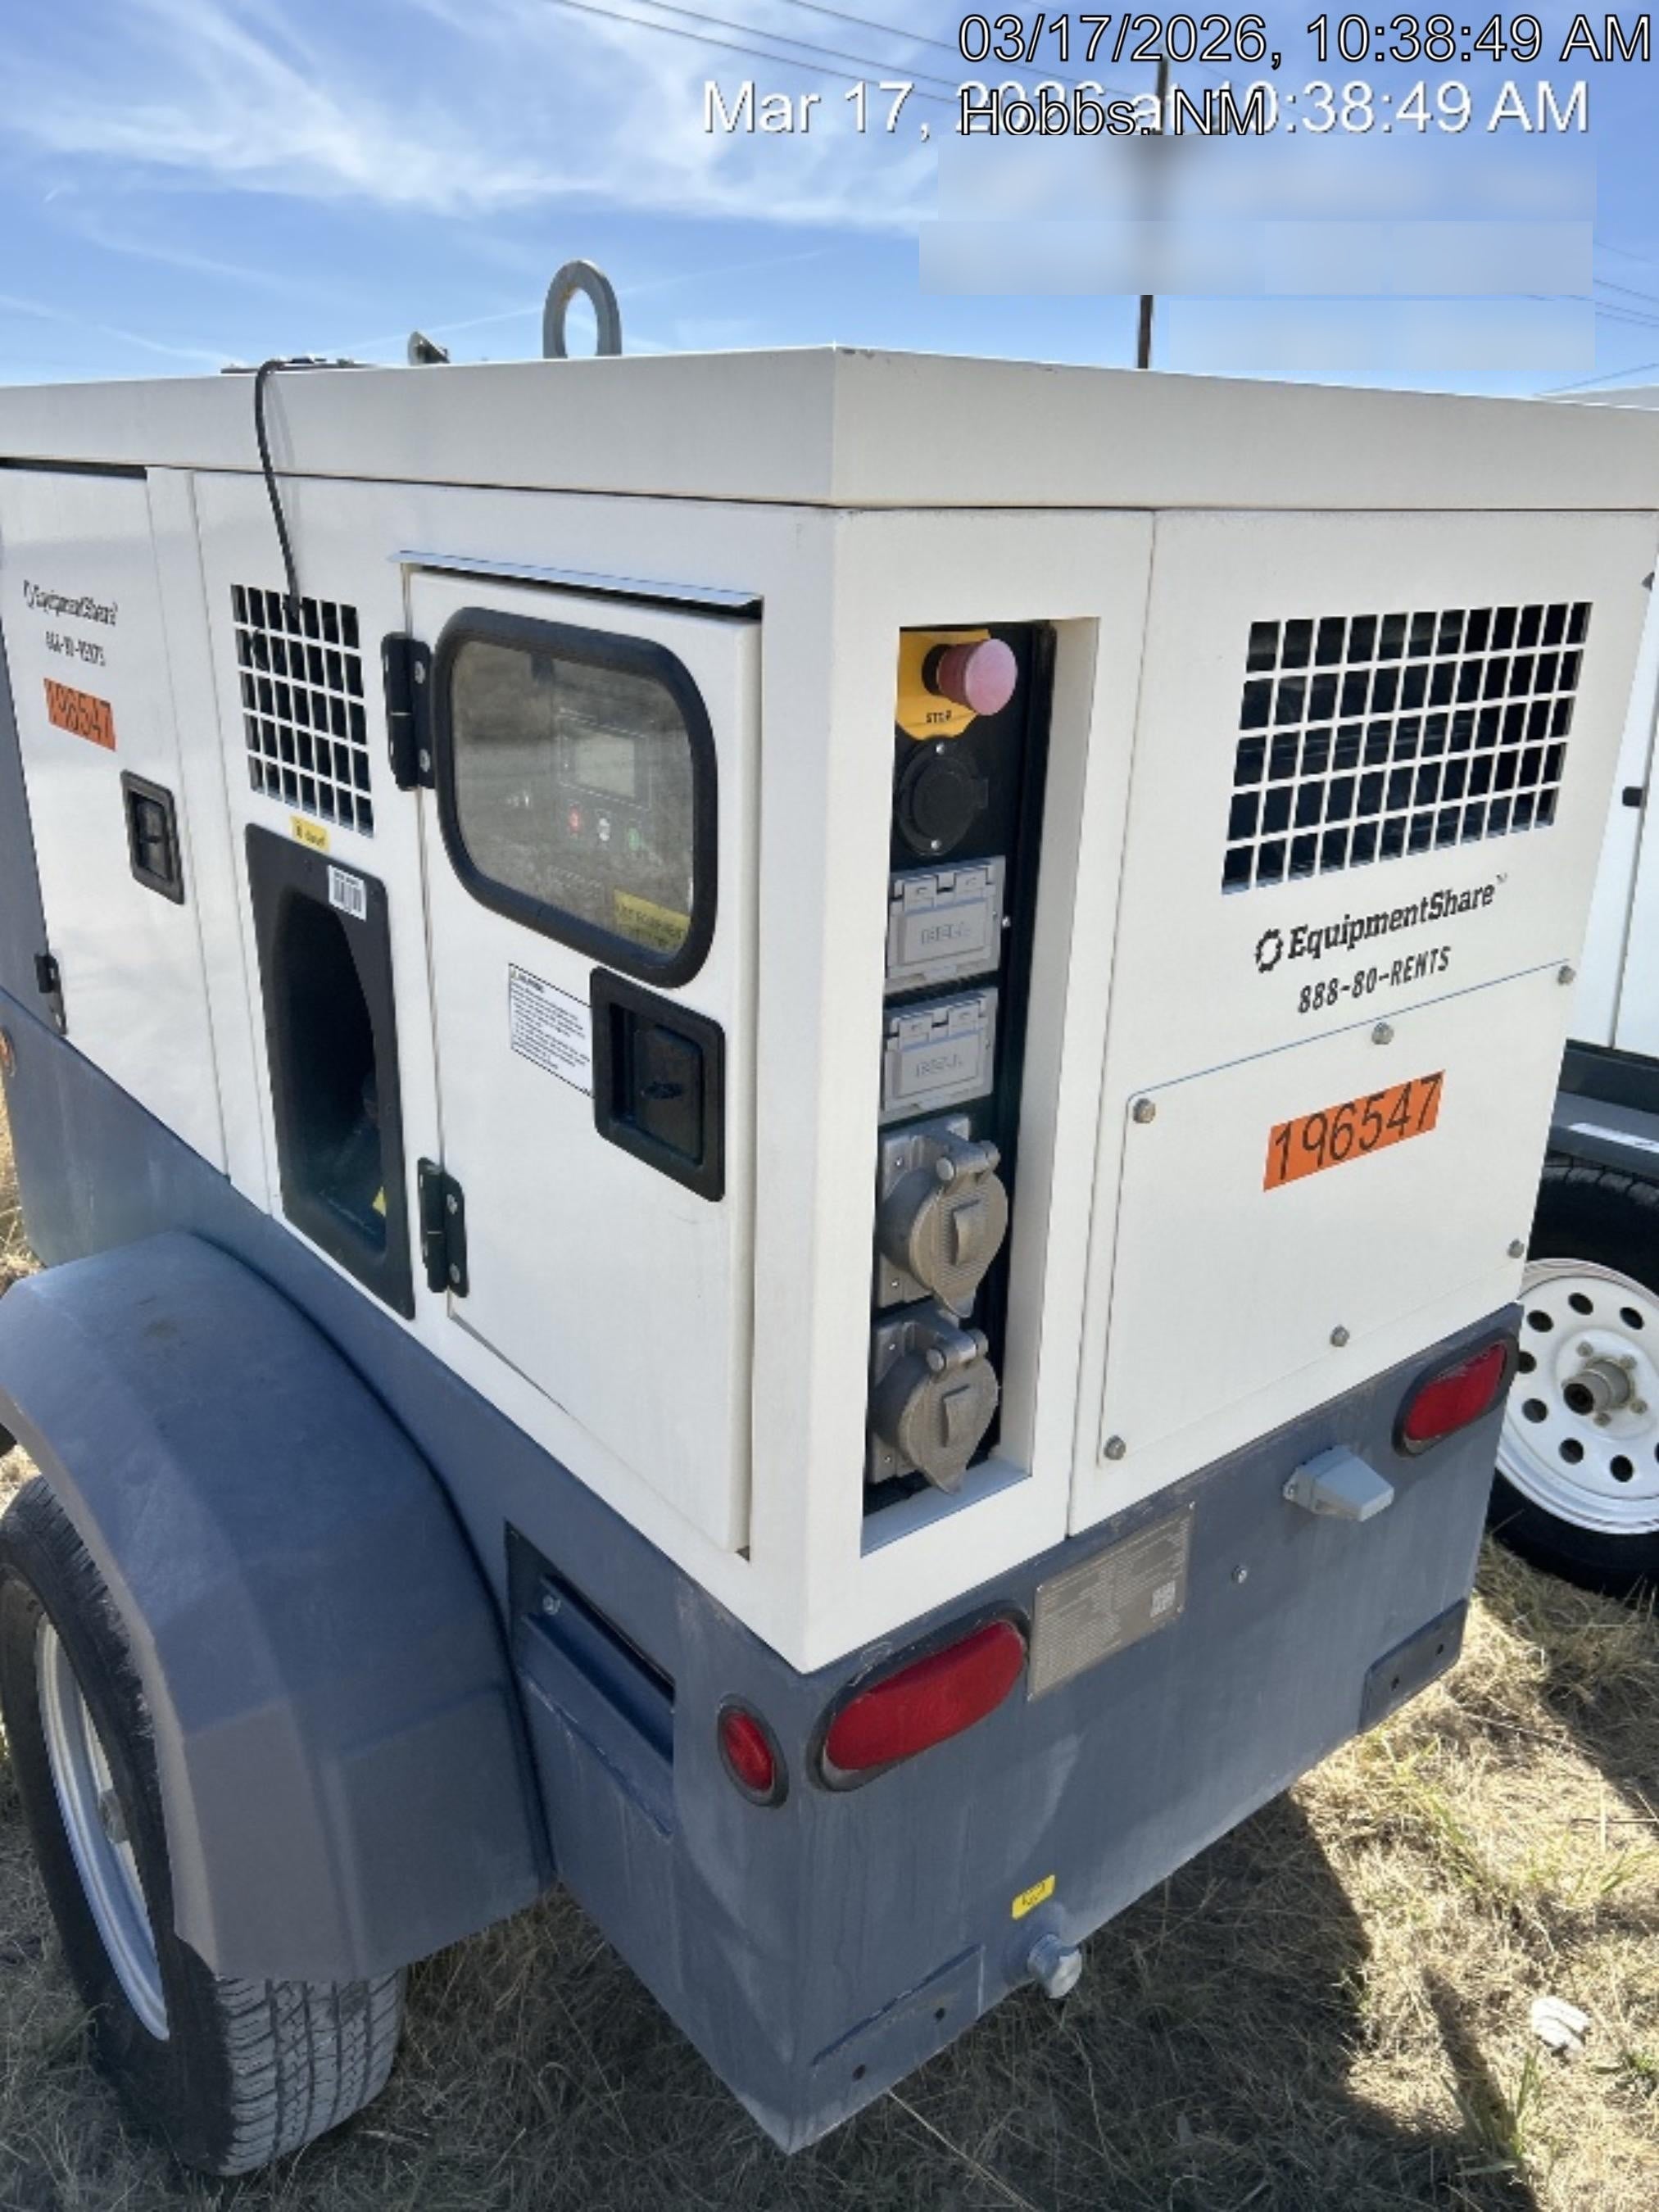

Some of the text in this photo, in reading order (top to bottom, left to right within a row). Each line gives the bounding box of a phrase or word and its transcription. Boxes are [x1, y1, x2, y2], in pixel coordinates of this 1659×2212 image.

[1287, 882, 1496, 960] EquipmentShare
[1297, 945, 1452, 1013] 888-80-RENTS
[1275, 1071, 1443, 1181] 196547
